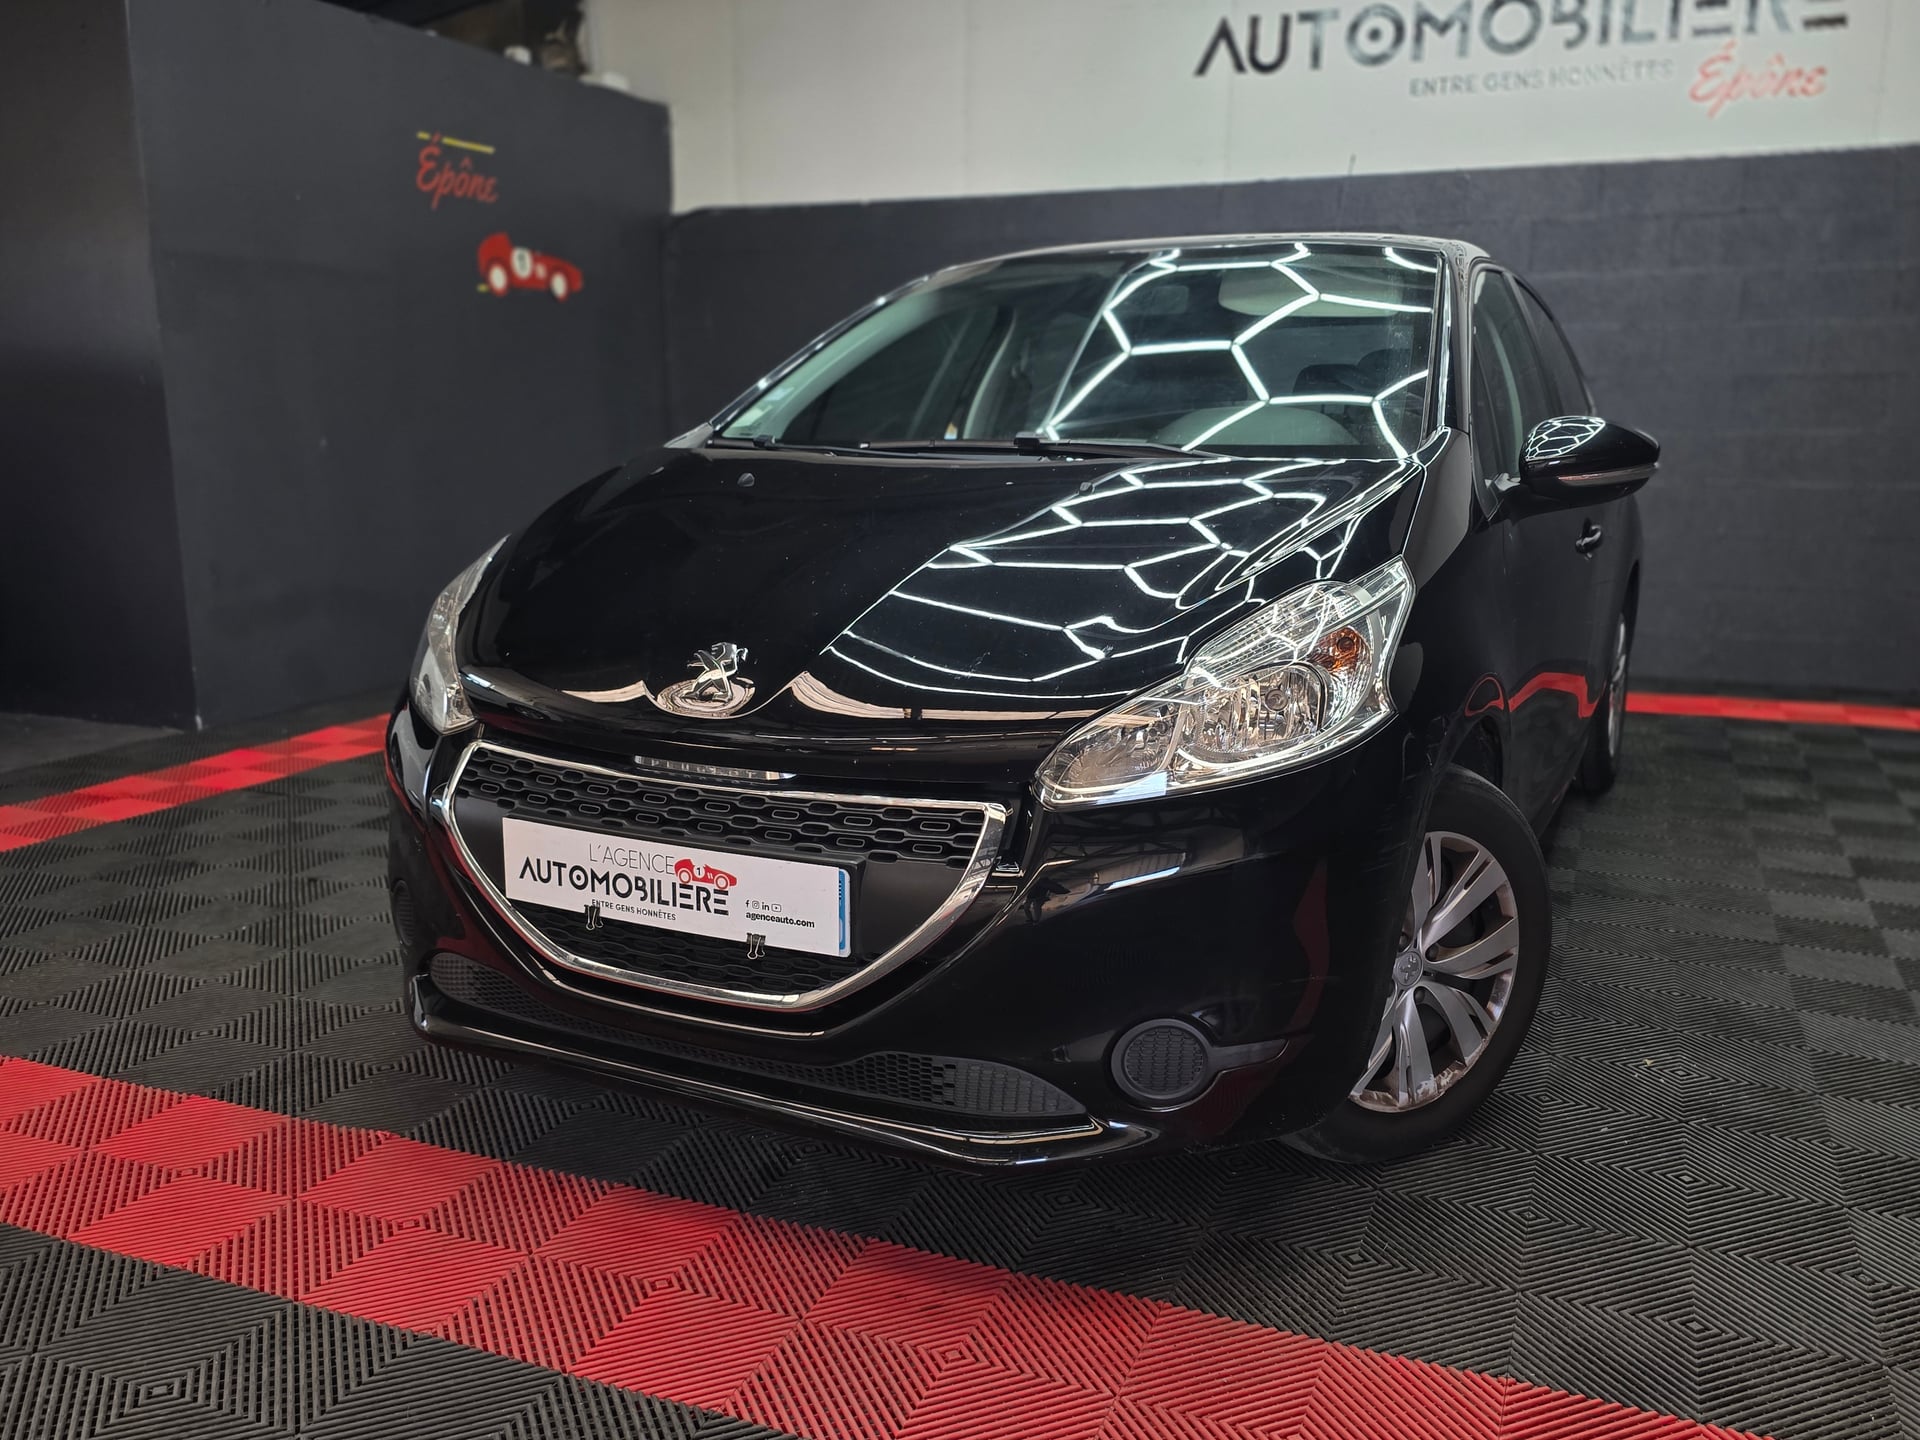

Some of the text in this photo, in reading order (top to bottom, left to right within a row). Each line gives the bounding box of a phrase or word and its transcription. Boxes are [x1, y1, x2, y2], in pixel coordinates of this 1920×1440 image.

[1408, 73, 1476, 97] ENTRE
[1483, 68, 1544, 92] GENS
[416, 131, 498, 211] Épône
[589, 843, 676, 875] L'AGENCE
[591, 899, 677, 921] ENTRE GENS HONNÊTES
[745, 912, 815, 928] agenceauto.com
